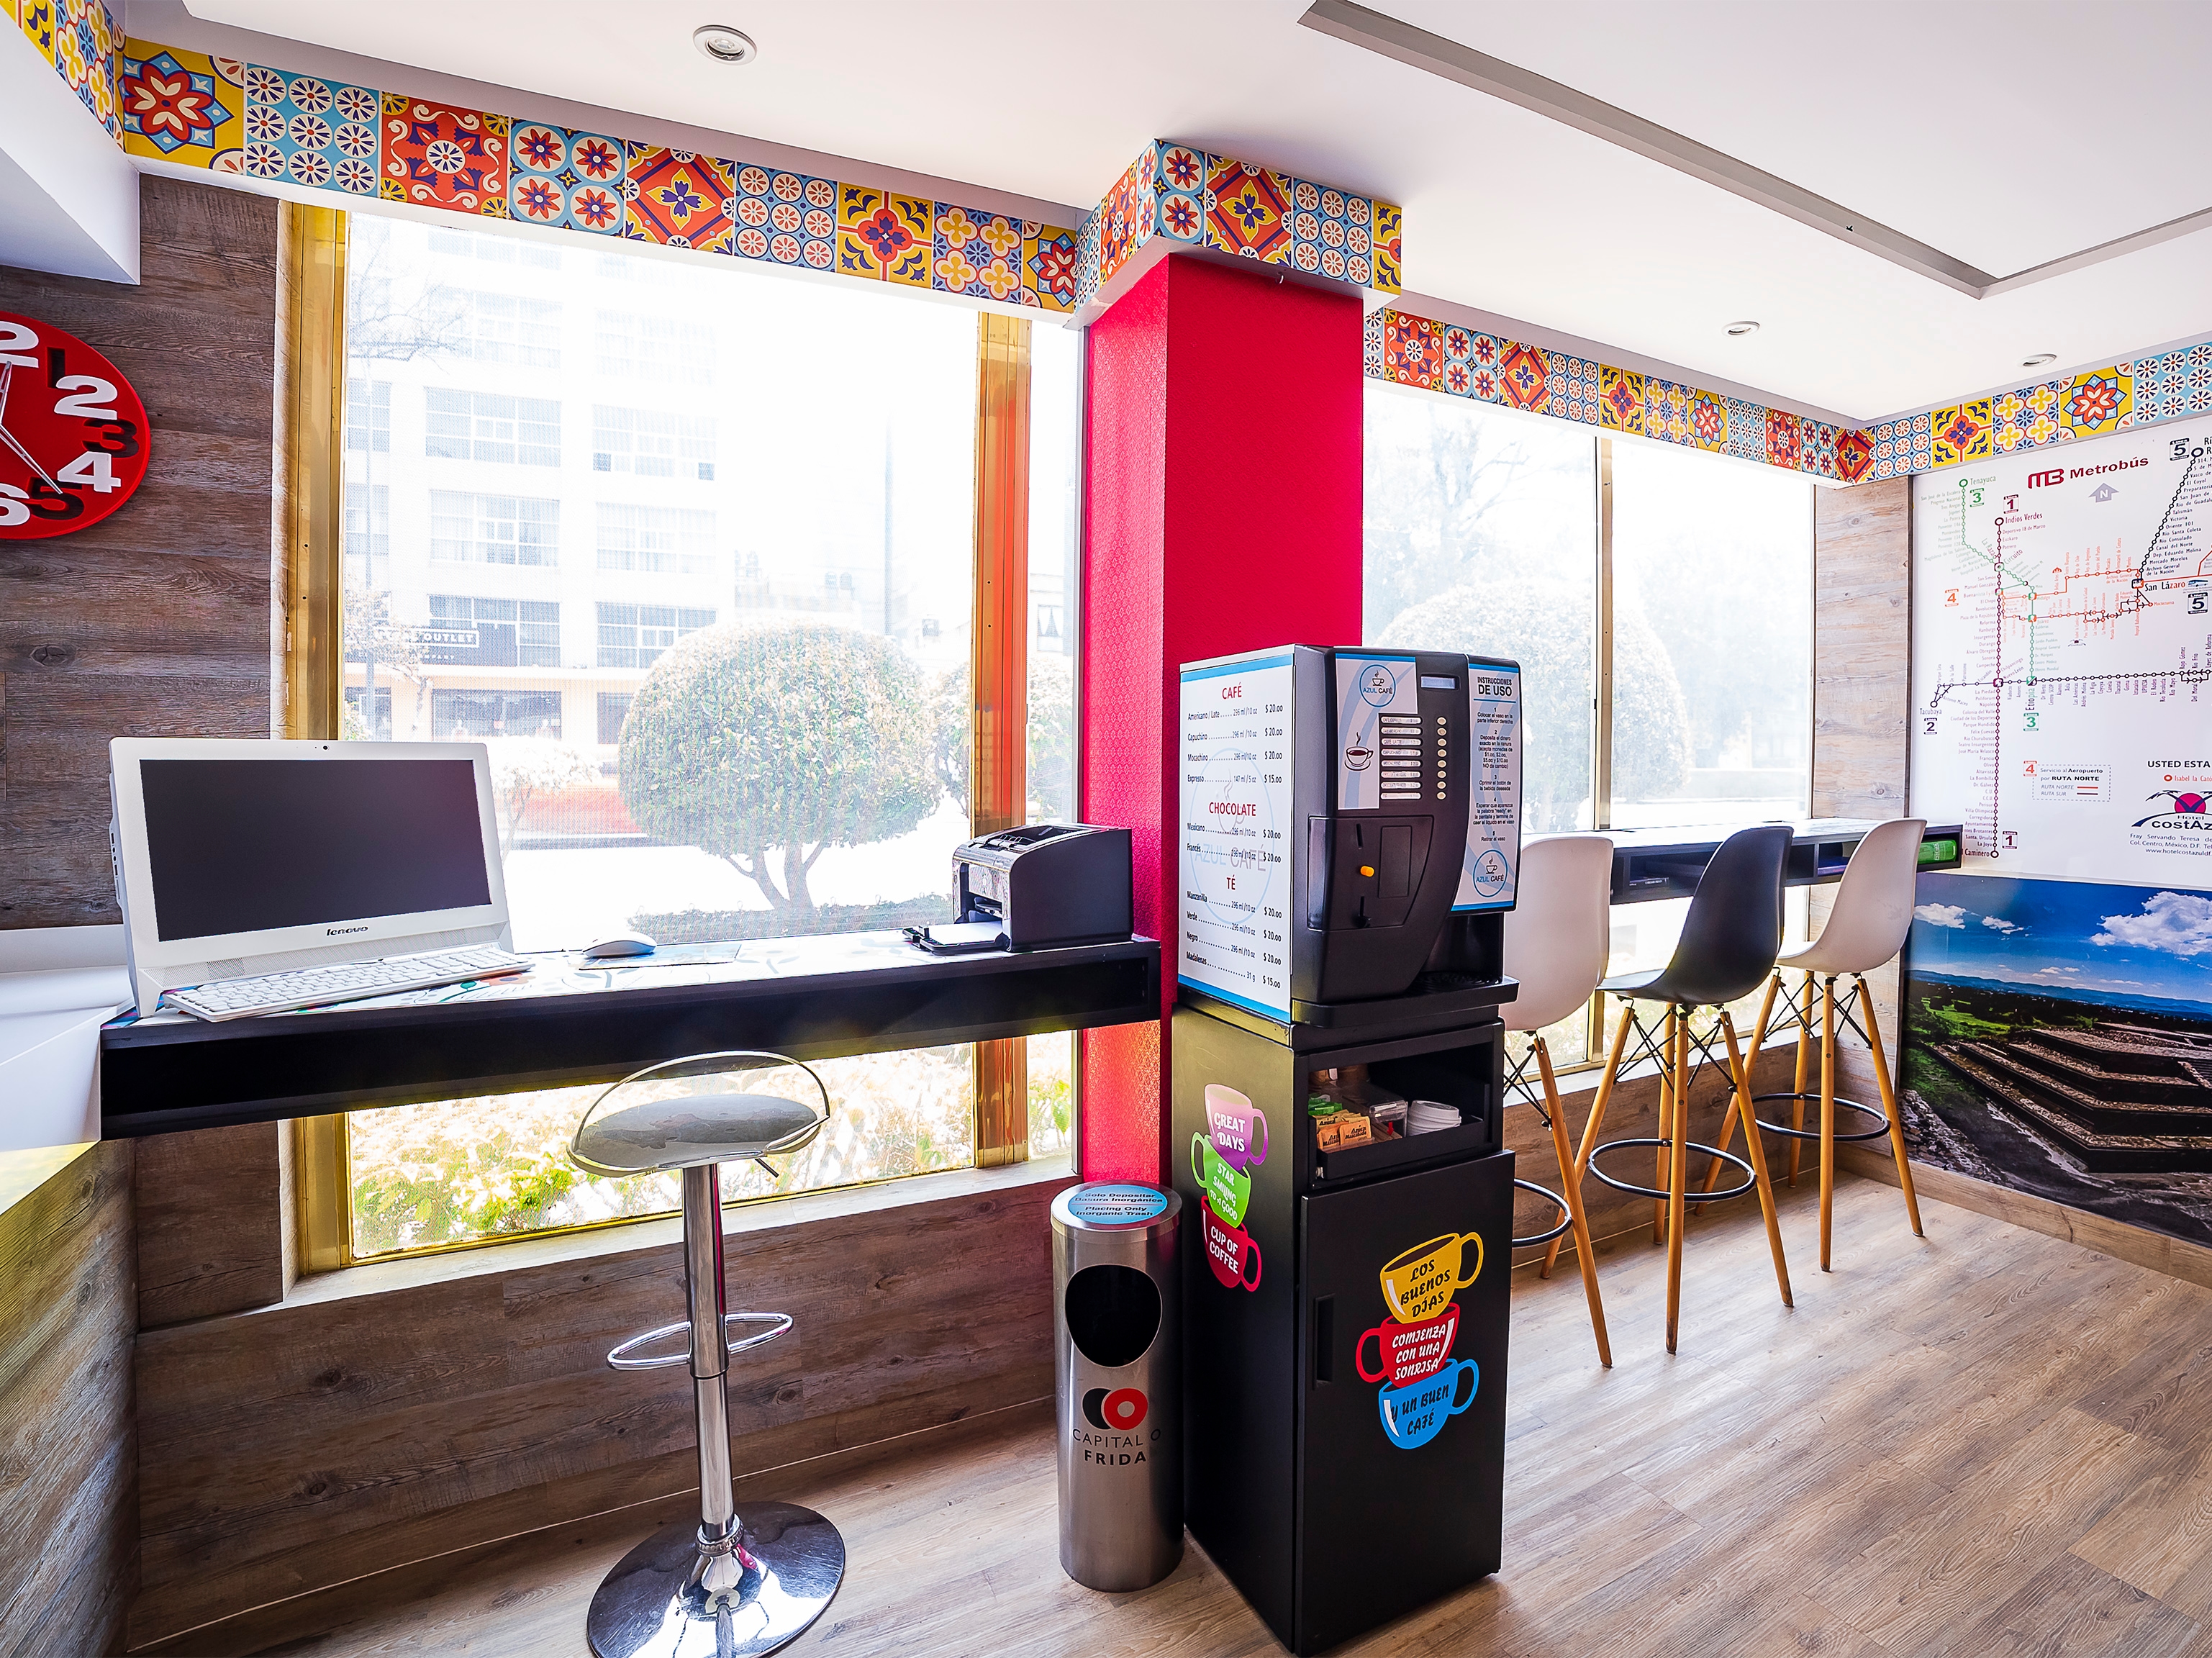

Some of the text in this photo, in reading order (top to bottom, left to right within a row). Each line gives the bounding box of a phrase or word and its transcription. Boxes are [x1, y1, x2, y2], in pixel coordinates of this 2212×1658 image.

[54, 375, 117, 420] 2
[82, 418, 139, 458] 3
[2174, 444, 2186, 456] 5
[58, 451, 121, 493] 4
[2070, 457, 2149, 479] Metrobús
[1970, 476, 1995, 485] Tenayuca
[1973, 493, 1981, 503] 3
[2007, 499, 2013, 509] 1
[2162, 581, 2185, 589] Lázaro
[1947, 593, 1957, 602] 4
[2192, 597, 2205, 610] 5
[424, 633, 473, 643] OUTLET
[1477, 676, 1512, 685] INSTRUCCIONES
[1222, 682, 1242, 699] CAFÉ
[1479, 684, 1512, 697] DE USO
[1265, 705, 1268, 713] $
[1926, 722, 1935, 731] 2
[2026, 717, 2036, 728] 3
[1188, 733, 1207, 743] Capuchino
[1265, 728, 1267, 736] $
[1264, 751, 1267, 760] $
[2026, 764, 2035, 773] 4
[1188, 774, 1204, 784] Expresso
[1264, 774, 1267, 783] $
[1209, 802, 1256, 816] CHOCOLATE
[1264, 829, 1266, 838] $
[2005, 835, 2012, 846] 1
[1187, 843, 1201, 852] Francés
[1264, 852, 1266, 861] $
[1195, 843, 1266, 871] AZUL CAFÉ
[1227, 874, 1236, 890] TÉ
[1187, 891, 1207, 902] Manzanilla
[1264, 906, 1267, 915] $
[327, 926, 368, 936] lenovo
[1187, 911, 1197, 920] Verde
[1264, 930, 1266, 938] $
[1187, 931, 1198, 943] Negro
[1264, 953, 1266, 961] $
[1187, 951, 1207, 965] Madalenas
[1213, 1112, 1246, 1133] GREAT
[1217, 1132, 1245, 1152] DAYS
[1218, 1162, 1235, 1186] STAR
[1212, 1176, 1236, 1208] SMILING
[1210, 1190, 1238, 1221] TO A GOOD
[1211, 1226, 1238, 1255] CUP OF
[1210, 1241, 1238, 1274] COFFEE
[1410, 1259, 1435, 1282] LOS
[1400, 1269, 1451, 1305] BUENOS
[1412, 1291, 1444, 1318] DÍAS
[1392, 1324, 1446, 1349] COMIENZA
[1396, 1341, 1440, 1364] CON UNA
[1395, 1359, 1440, 1380] SONRISA
[1390, 1383, 1449, 1423] Y UN BUEN
[1408, 1408, 1435, 1436] CAFÉ
[1073, 1428, 1161, 1448] CAPITAL O
[1084, 1449, 1146, 1466] FRIDA
